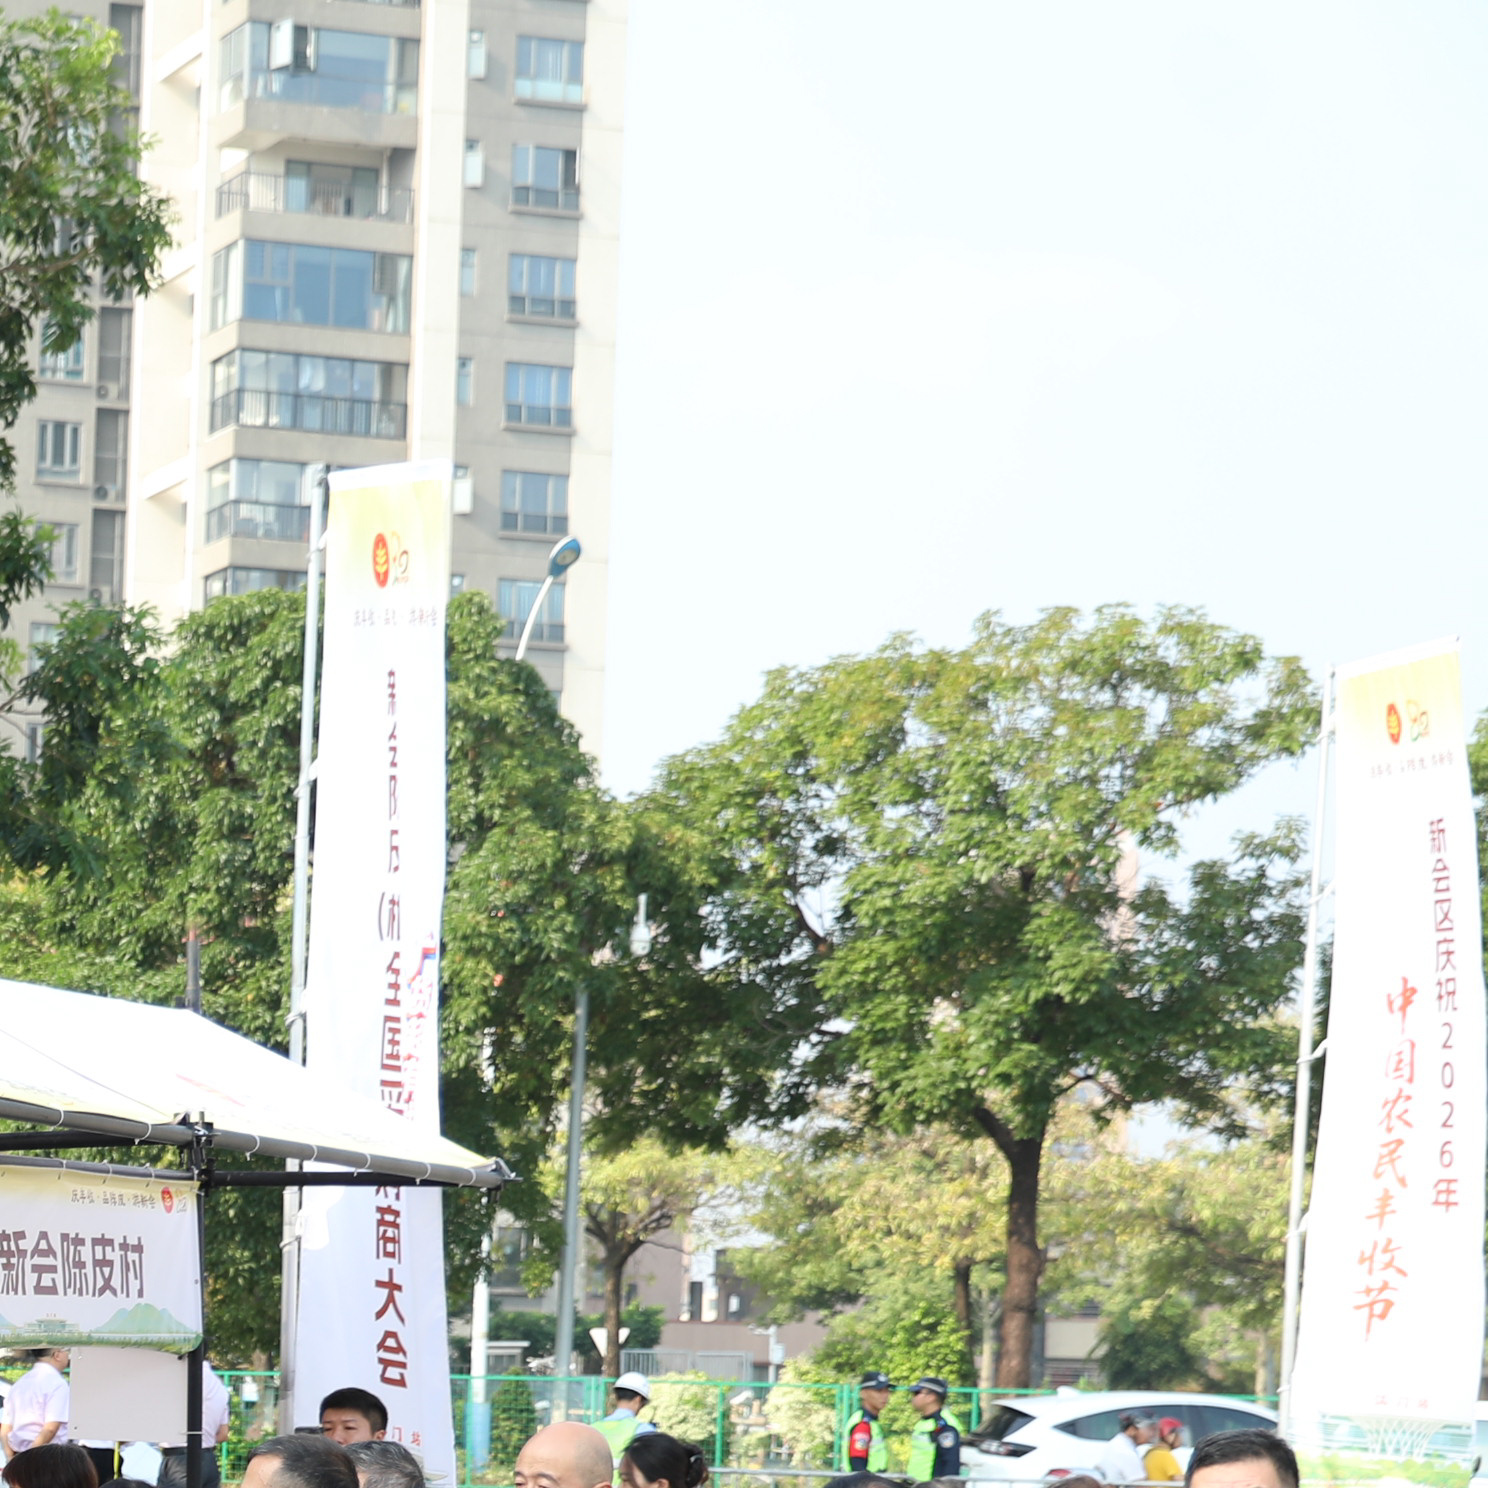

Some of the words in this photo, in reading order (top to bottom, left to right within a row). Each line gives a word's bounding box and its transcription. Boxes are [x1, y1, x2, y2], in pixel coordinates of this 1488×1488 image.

[1353, 976, 1418, 1341] 中国农民丰收节
[1429, 818, 1459, 1213] 新会区庆祝2026年
